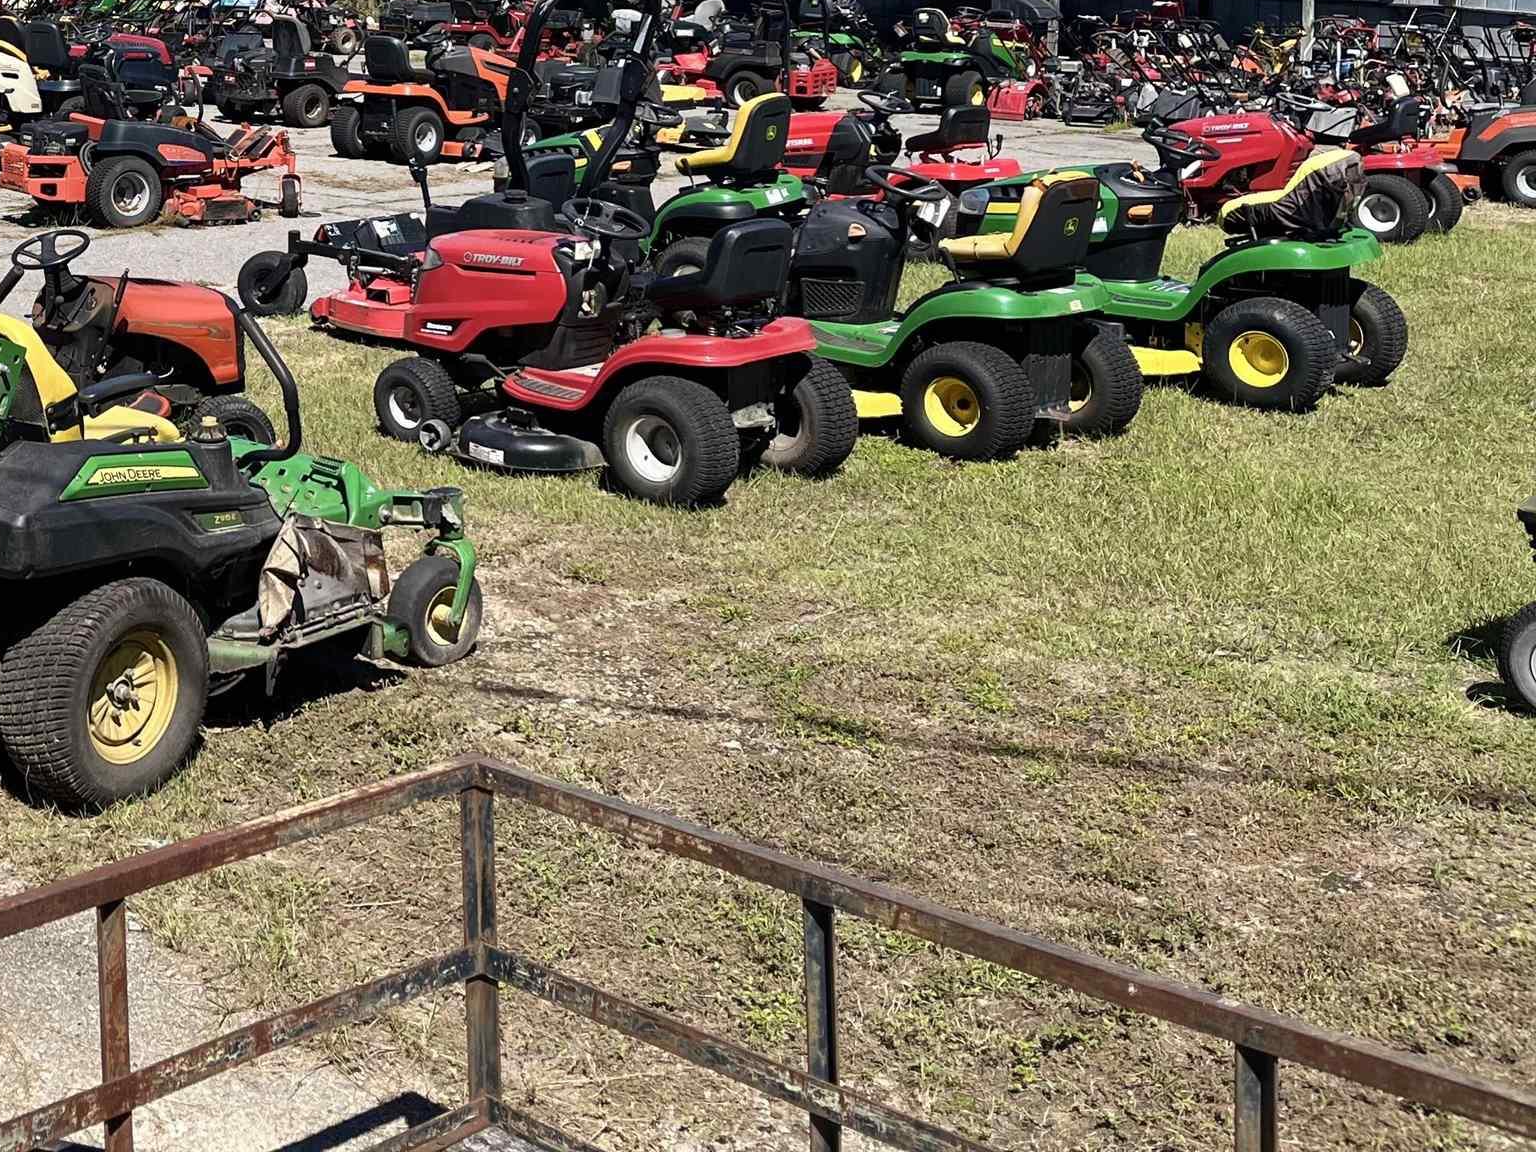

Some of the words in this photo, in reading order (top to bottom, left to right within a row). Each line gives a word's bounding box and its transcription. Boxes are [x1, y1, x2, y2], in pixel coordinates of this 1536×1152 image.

[472, 253, 526, 267] TROY-BILT
[99, 469, 127, 483] JOHN
[128, 468, 162, 480] DEERE
